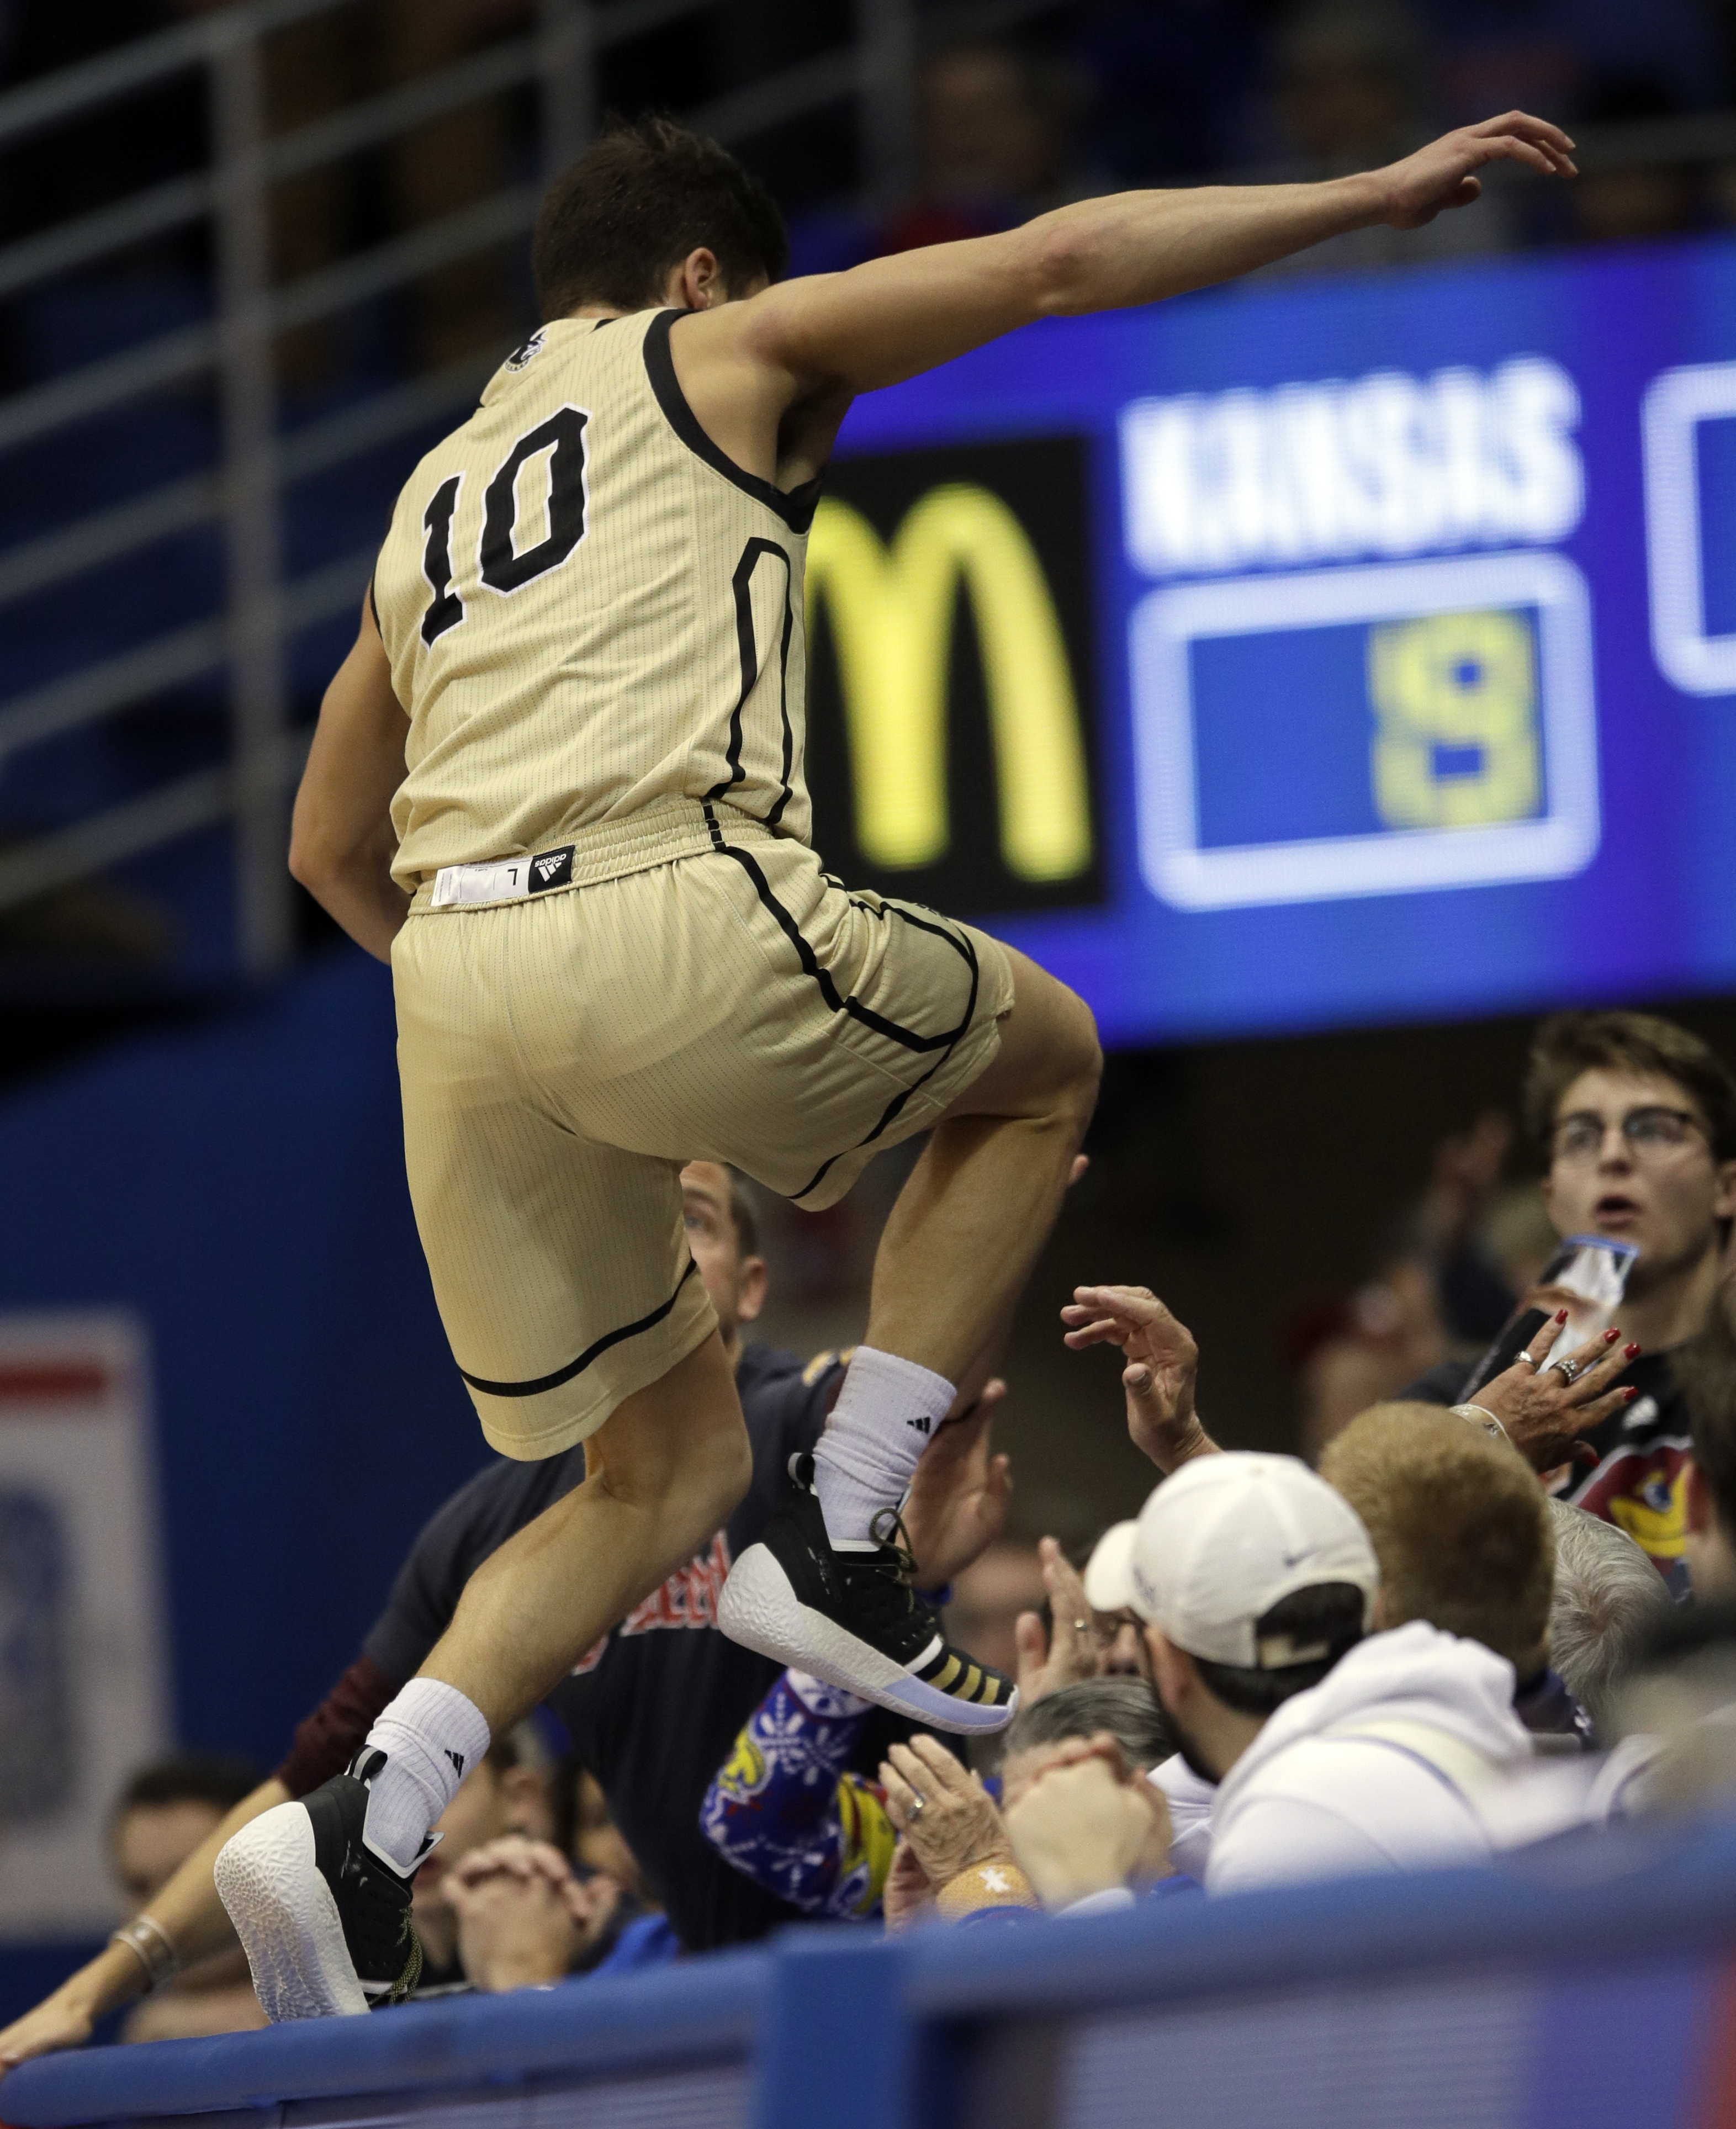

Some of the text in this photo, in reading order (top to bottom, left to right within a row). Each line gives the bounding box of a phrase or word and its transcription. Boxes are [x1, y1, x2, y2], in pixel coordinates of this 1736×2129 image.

[1121, 354, 1584, 576] KANSAS
[420, 403, 591, 649] 10
[507, 868, 518, 886] L
[534, 853, 567, 867] adidas
